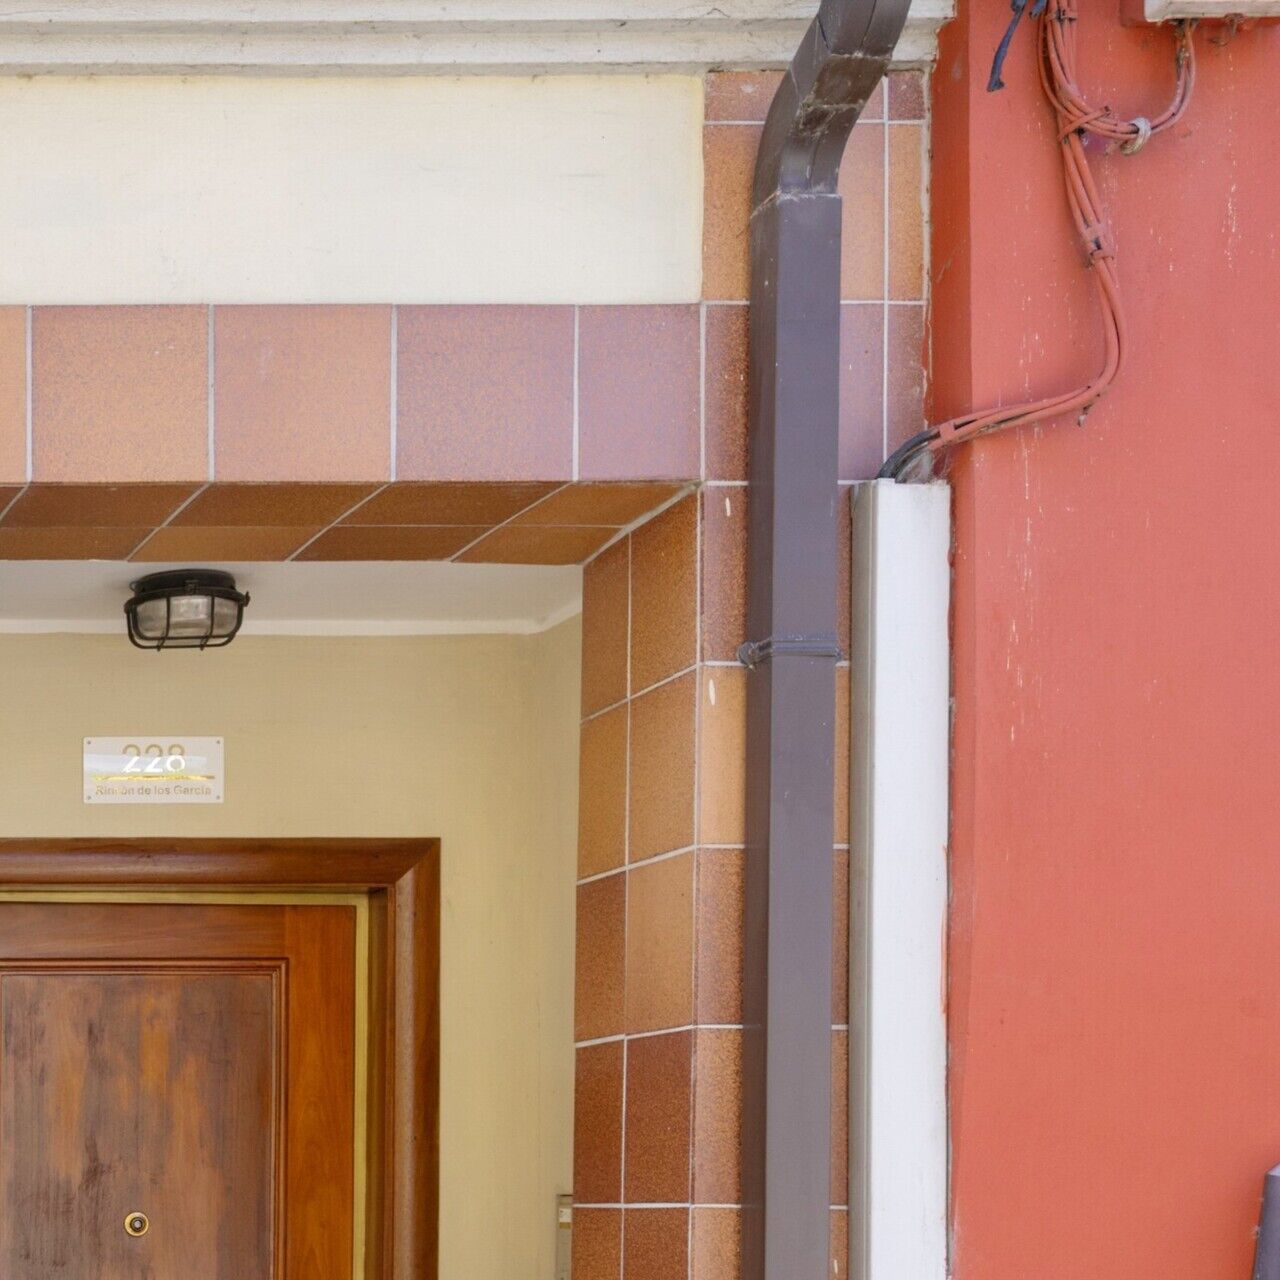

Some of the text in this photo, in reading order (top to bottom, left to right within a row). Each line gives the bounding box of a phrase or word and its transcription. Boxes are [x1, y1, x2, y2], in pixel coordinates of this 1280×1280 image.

[122, 744, 185, 773] 228
[137, 785, 151, 795] de
[154, 785, 170, 795] los
